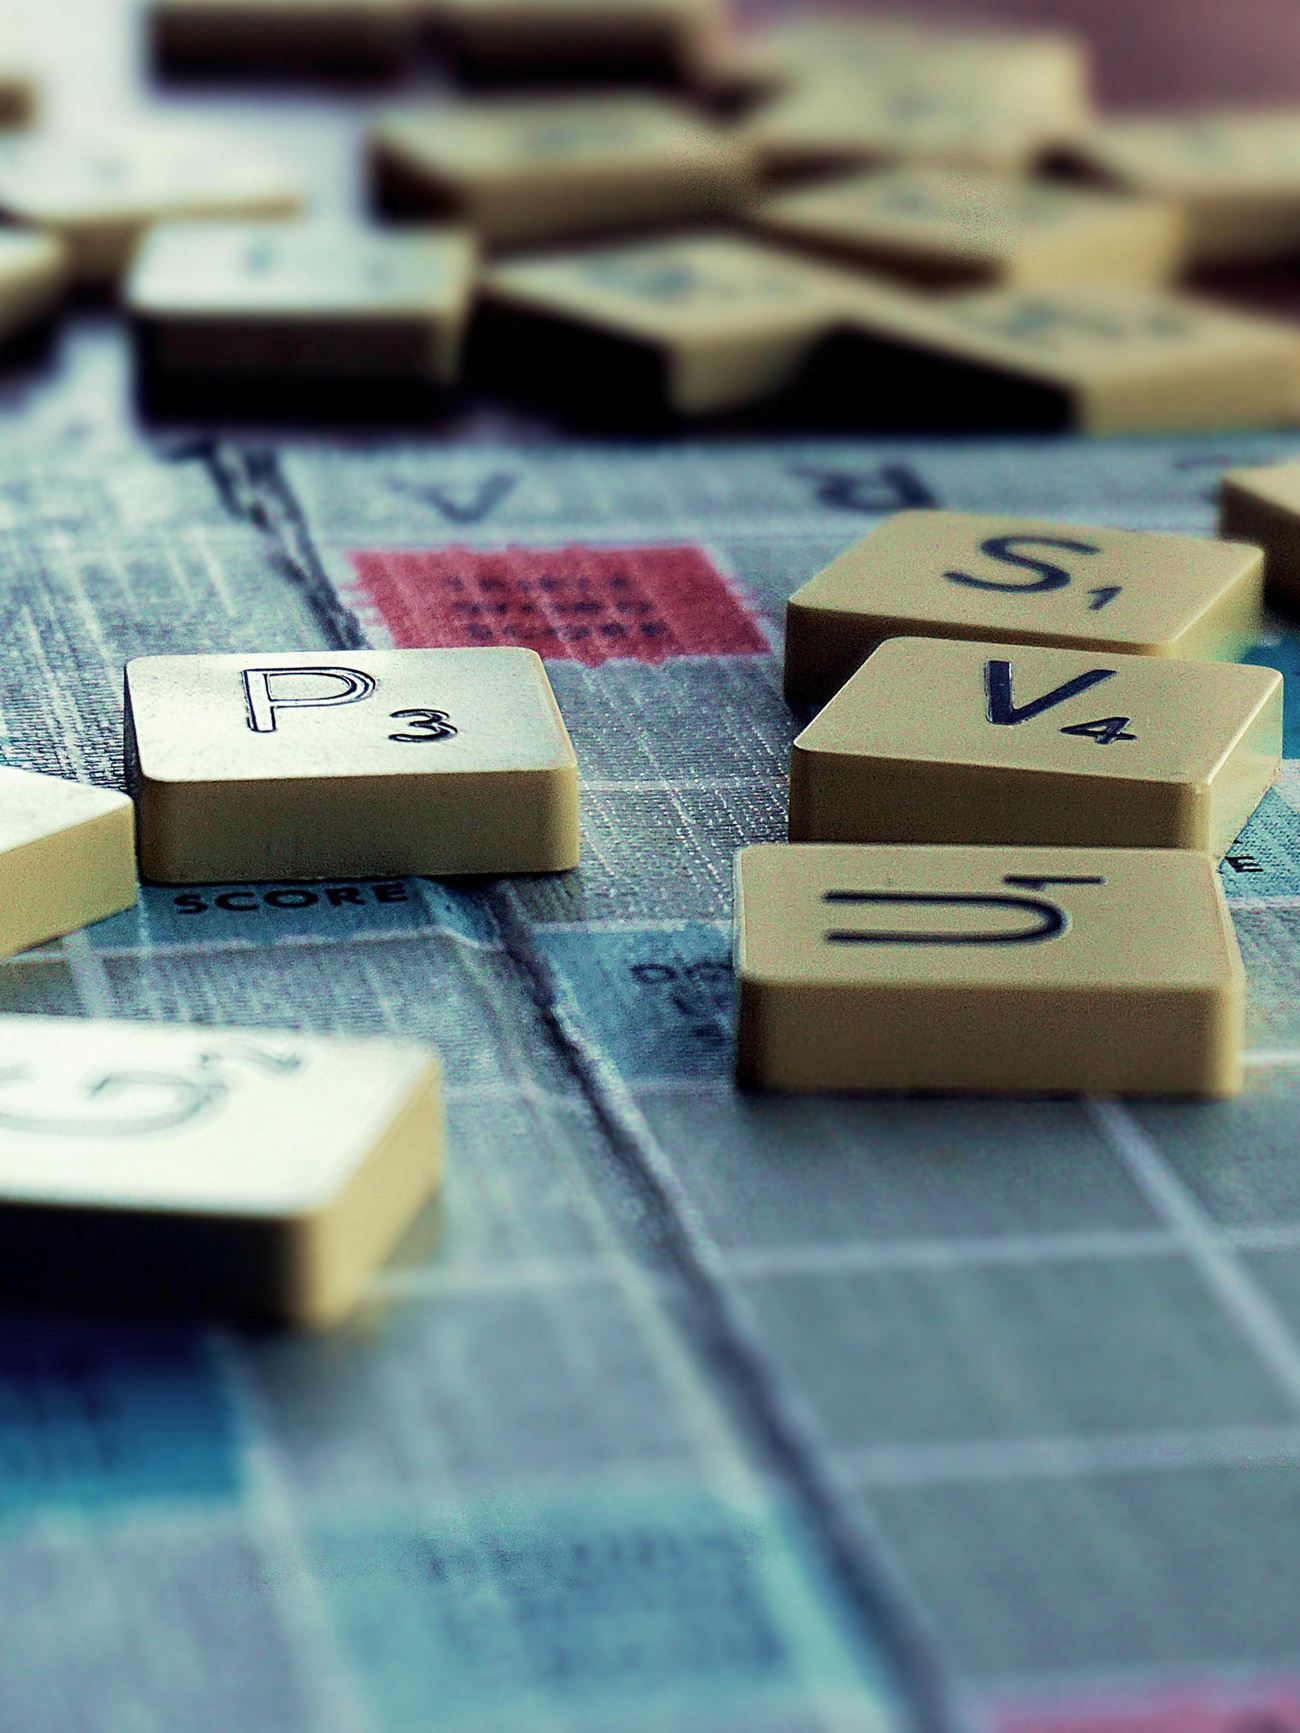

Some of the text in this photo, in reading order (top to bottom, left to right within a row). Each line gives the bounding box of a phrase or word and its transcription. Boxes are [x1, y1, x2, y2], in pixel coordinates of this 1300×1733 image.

[941, 533, 1099, 594] S
[240, 666, 458, 743] P 3
[983, 659, 1137, 745] V 4
[174, 882, 409, 915] SCORE
